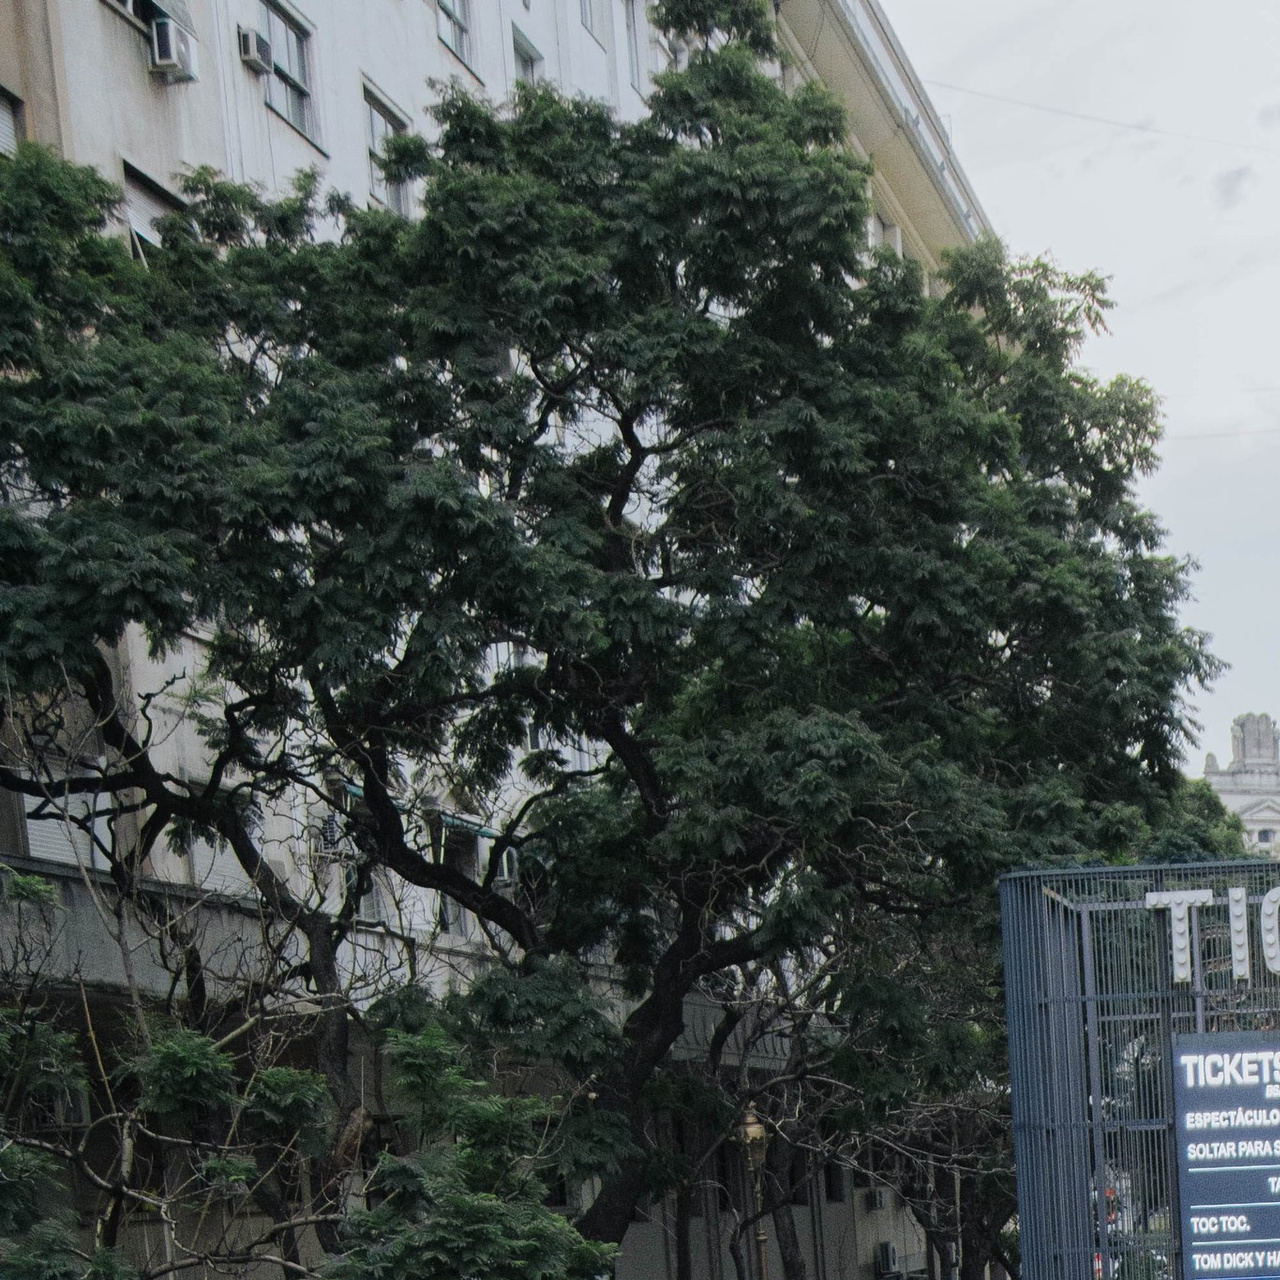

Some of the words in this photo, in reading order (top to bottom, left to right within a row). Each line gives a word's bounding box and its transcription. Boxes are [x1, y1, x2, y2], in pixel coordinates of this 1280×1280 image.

[1187, 1142, 1236, 1160] SOLTAR
[1238, 1140, 1272, 1158] PARA
[1190, 1217, 1218, 1233] TOC
[1219, 1215, 1250, 1233] TOC.
[1193, 1253, 1222, 1270] TOM
[1224, 1252, 1254, 1269] DICK
[1256, 1251, 1266, 1267] Y
